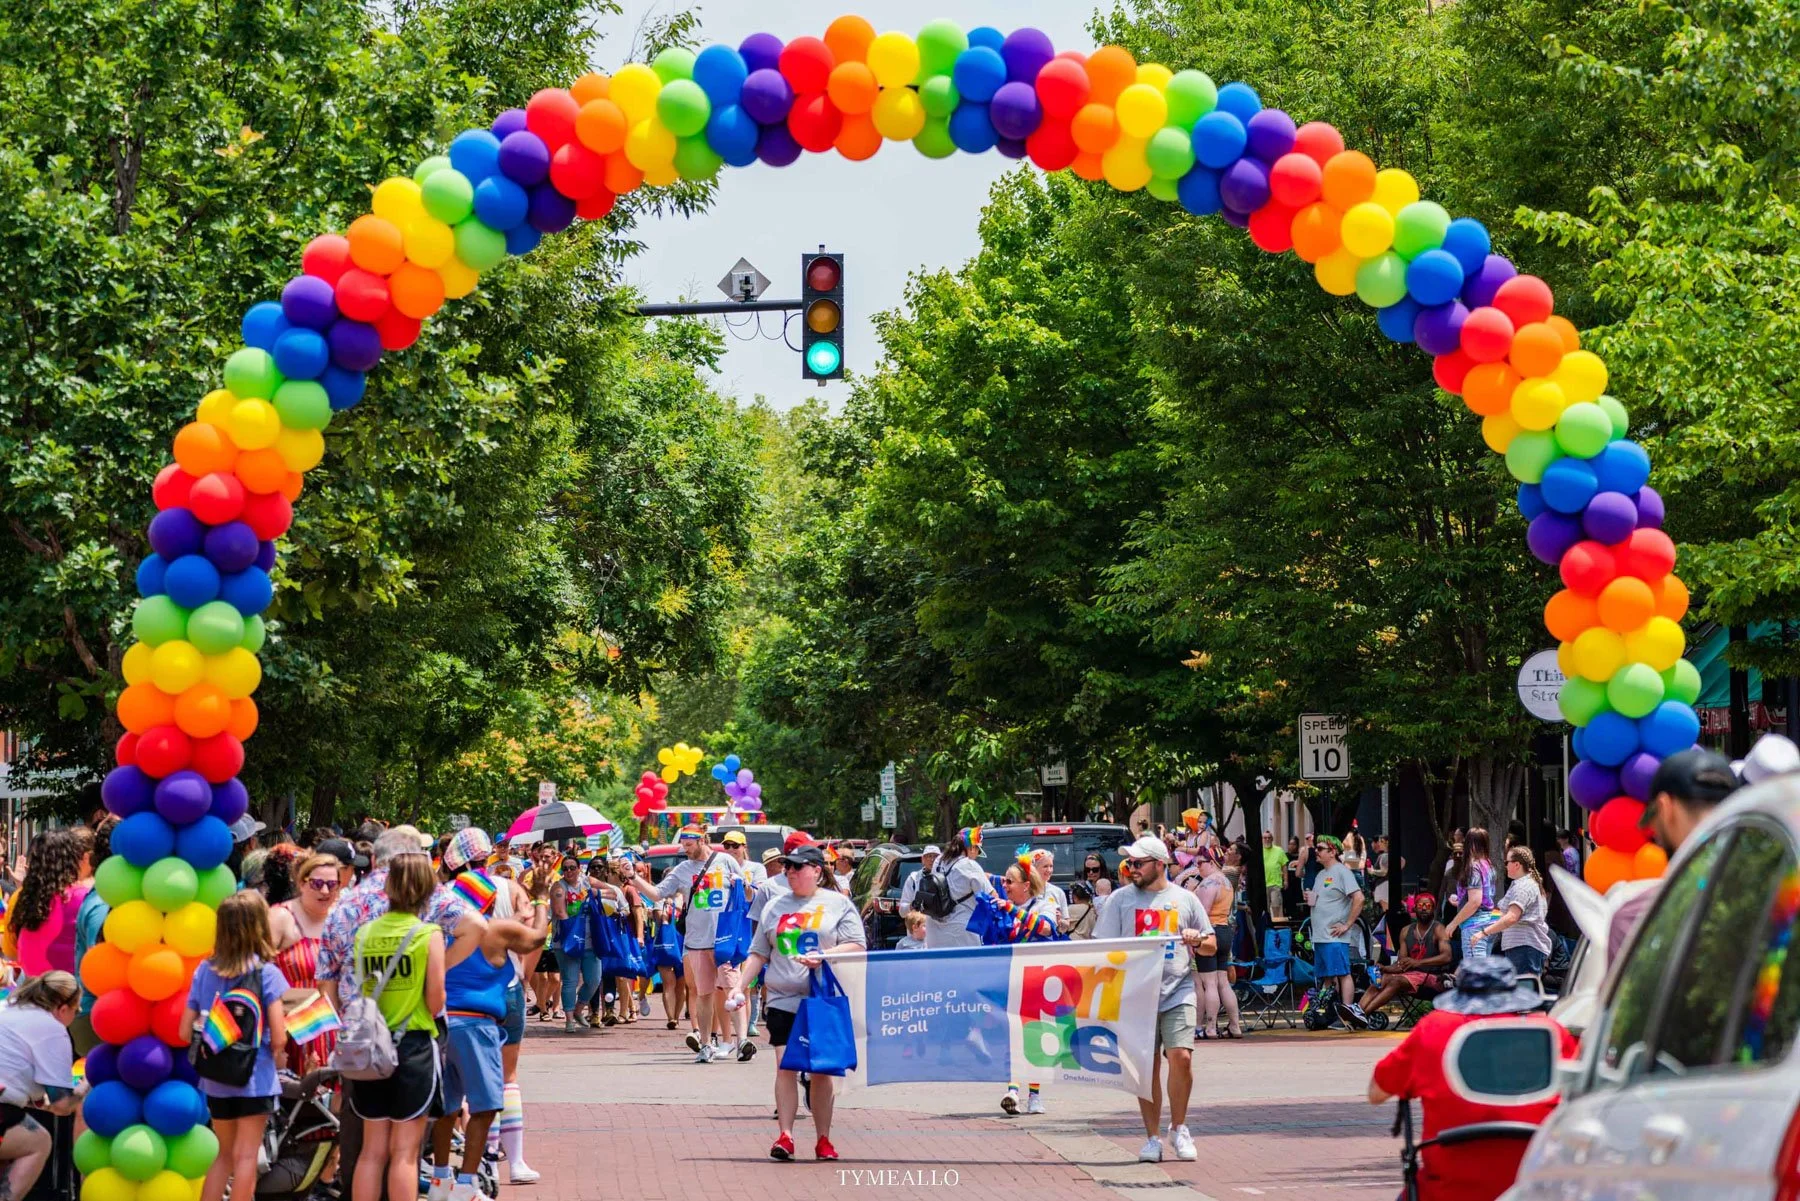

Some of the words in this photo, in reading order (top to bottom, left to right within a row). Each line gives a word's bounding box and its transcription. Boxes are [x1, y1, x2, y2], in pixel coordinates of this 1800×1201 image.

[1308, 734, 1341, 745] LIMIT
[1312, 748, 1341, 772] 10
[881, 991, 942, 1007] Building
[946, 989, 957, 999] a
[881, 1006, 941, 1022] brighter
[945, 1001, 992, 1015] future
[881, 1024, 903, 1037] for
[907, 1020, 928, 1034] all
